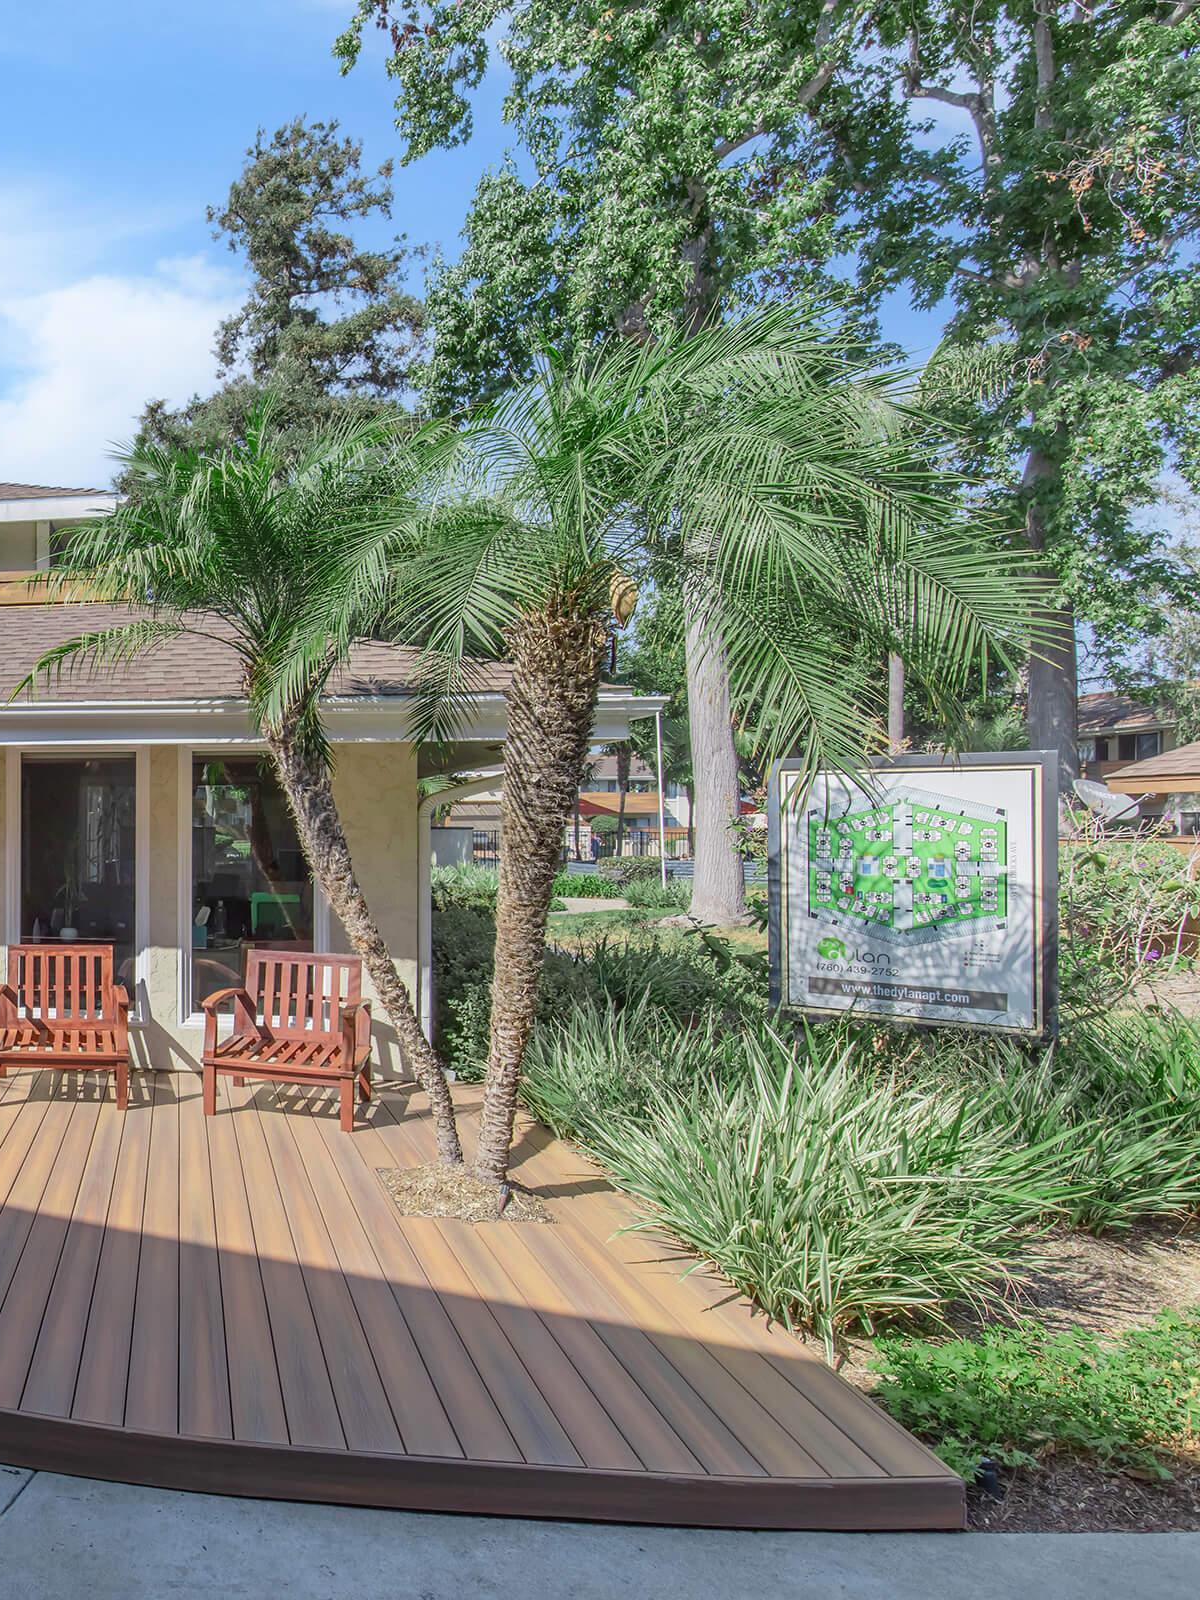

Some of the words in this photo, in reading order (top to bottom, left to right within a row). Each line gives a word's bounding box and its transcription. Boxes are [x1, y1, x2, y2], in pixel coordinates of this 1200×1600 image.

[817, 962, 844, 973] (760)
[846, 965, 899, 977] 439-2752
[841, 983, 970, 1004] www.thedylanapt.com
